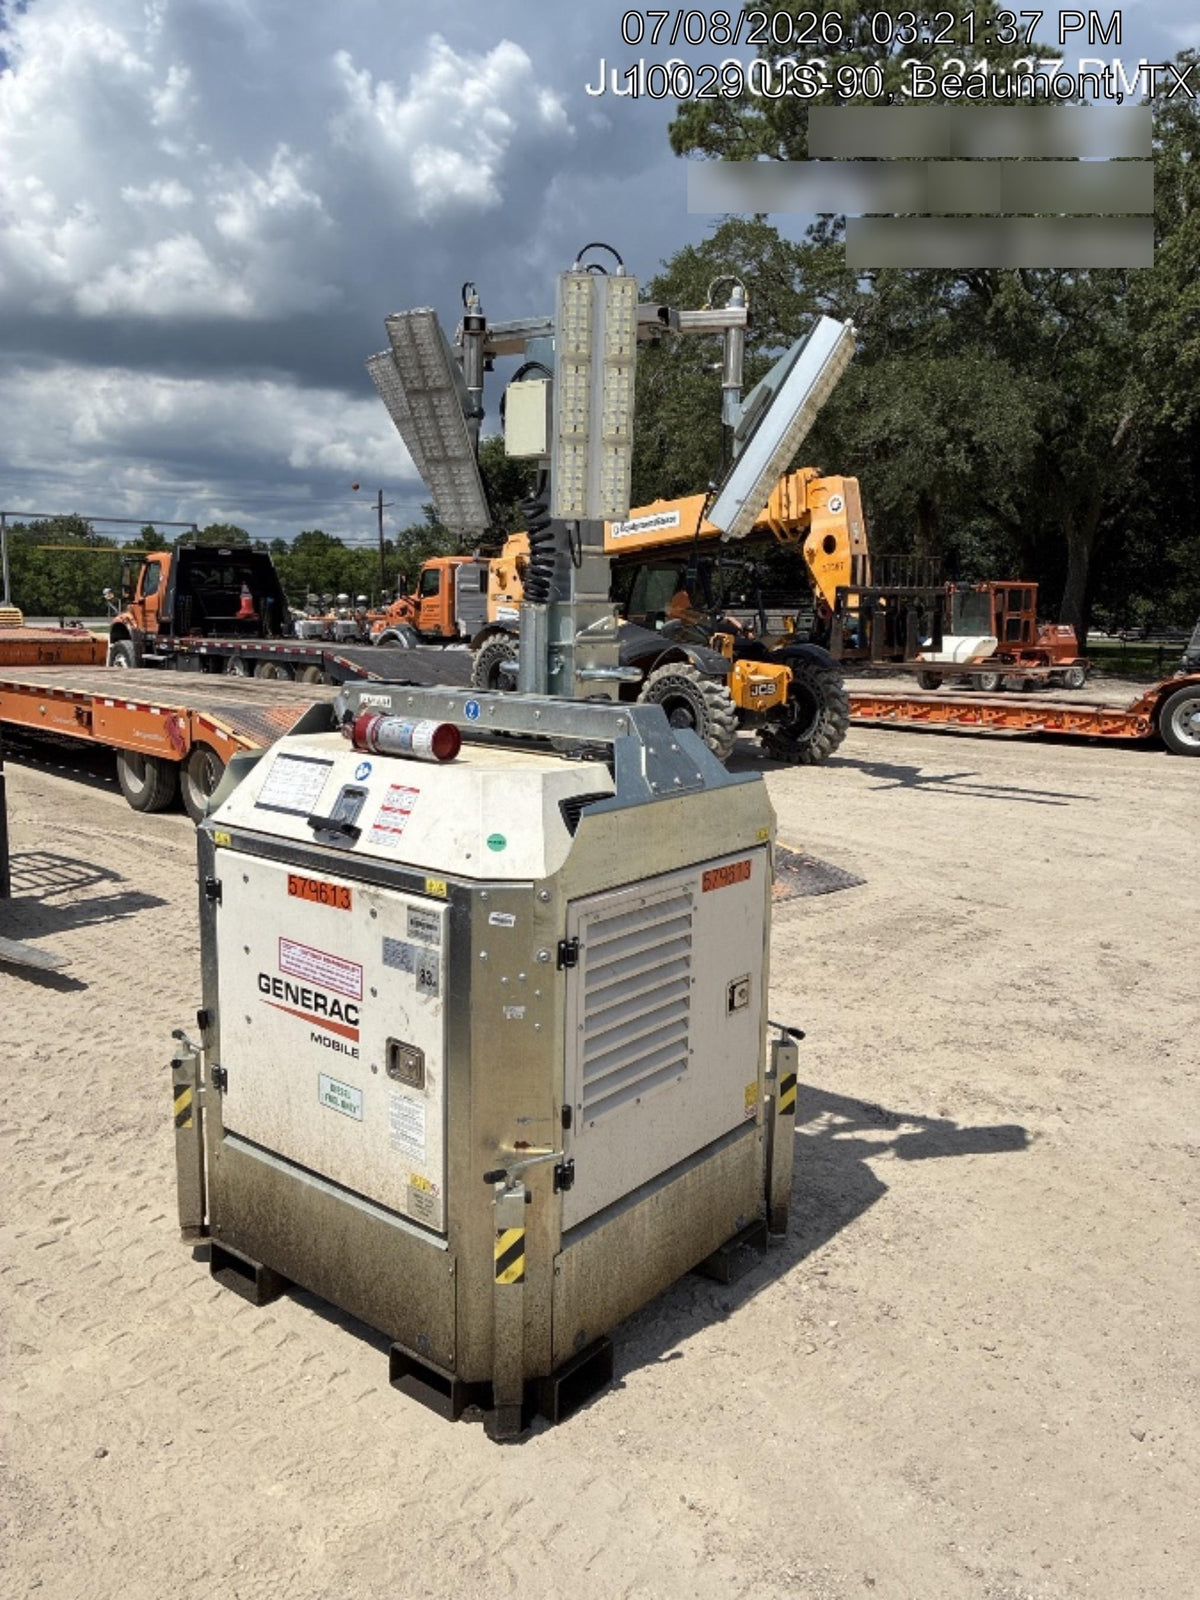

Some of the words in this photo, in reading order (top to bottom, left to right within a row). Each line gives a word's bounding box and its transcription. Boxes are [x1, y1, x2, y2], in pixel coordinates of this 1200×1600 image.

[750, 682, 777, 697] JCB
[288, 875, 351, 909] 579613
[257, 973, 360, 1026] GENERAC
[310, 1032, 360, 1059] MOBILE
